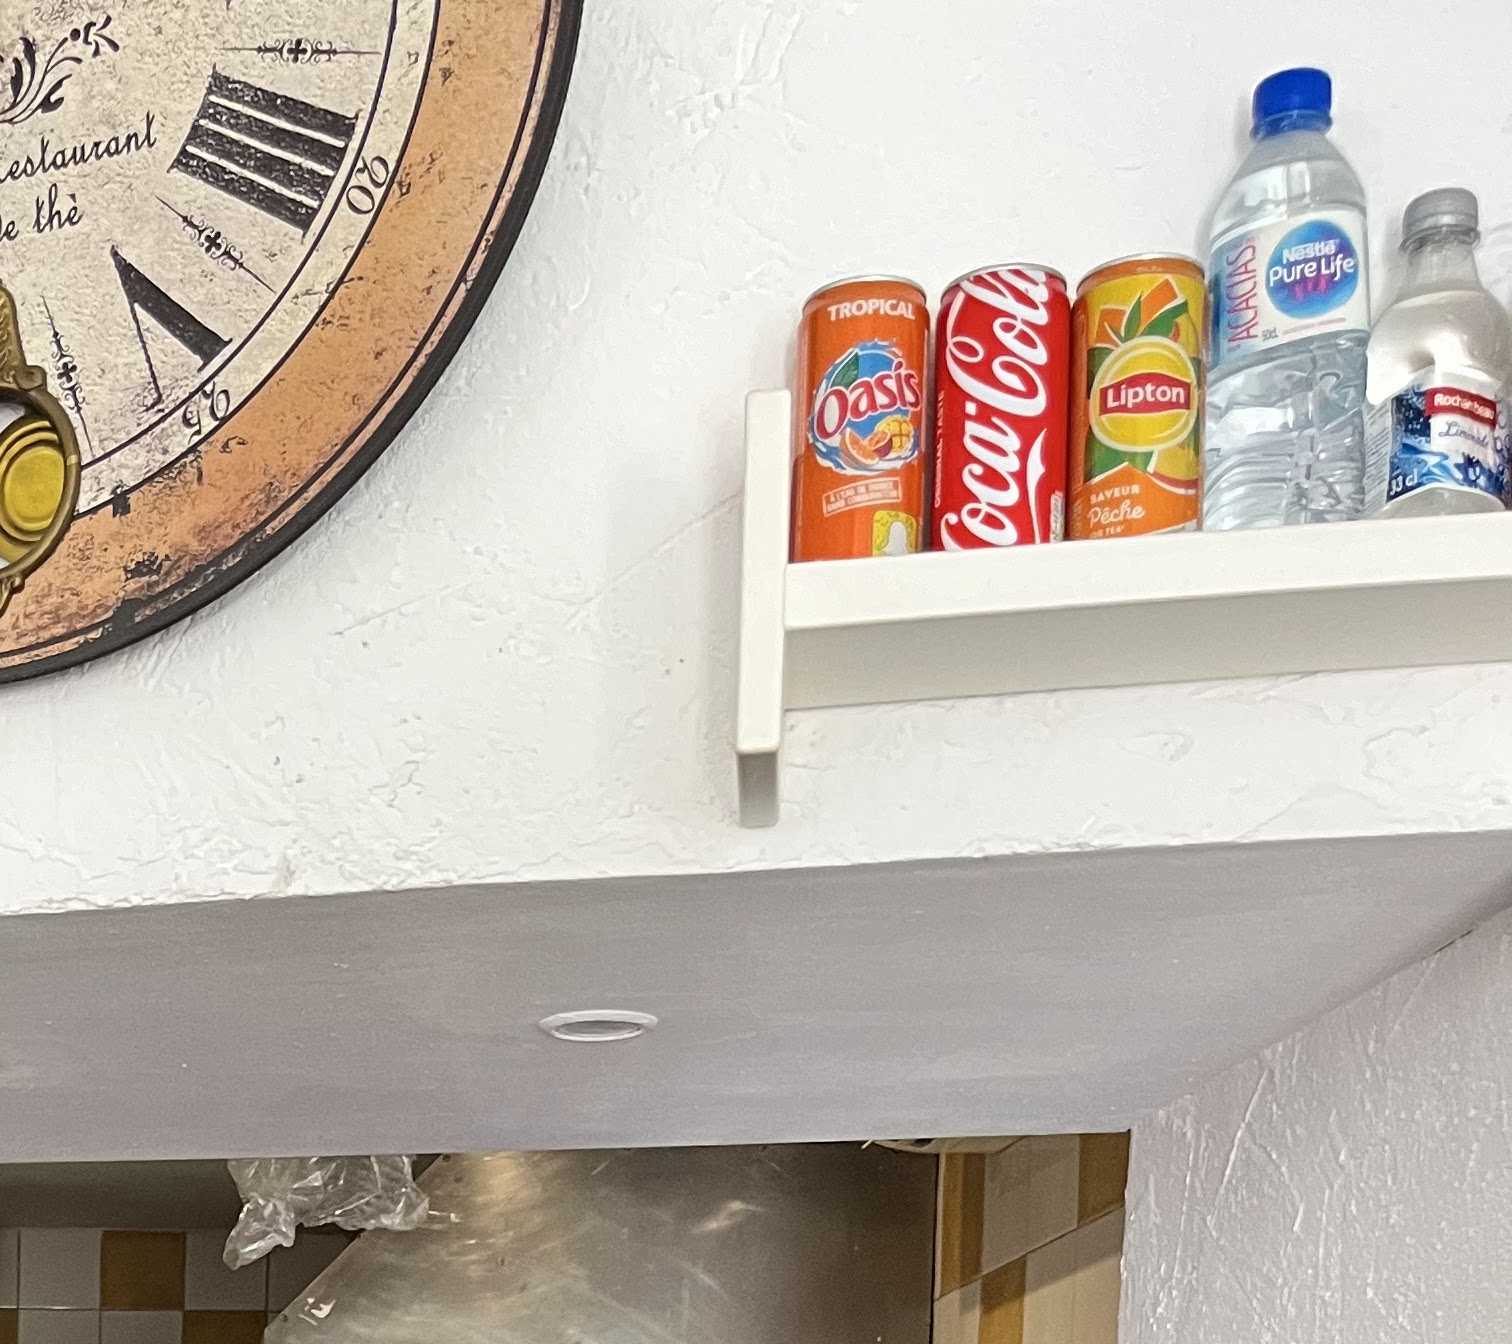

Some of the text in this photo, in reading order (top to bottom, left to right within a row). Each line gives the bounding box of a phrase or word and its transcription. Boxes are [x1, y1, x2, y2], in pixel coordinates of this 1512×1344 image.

[345, 154, 391, 217] 20
[1269, 253, 1355, 287] Pure Life
[827, 298, 916, 321] TROPICAL
[1225, 244, 1259, 344] ACACIAS
[814, 358, 922, 441] Oasis
[1106, 382, 1185, 409] Lipton
[181, 380, 231, 446] 25
[1090, 484, 1140, 504] SAVEUR
[1088, 498, 1145, 529] Pêche
